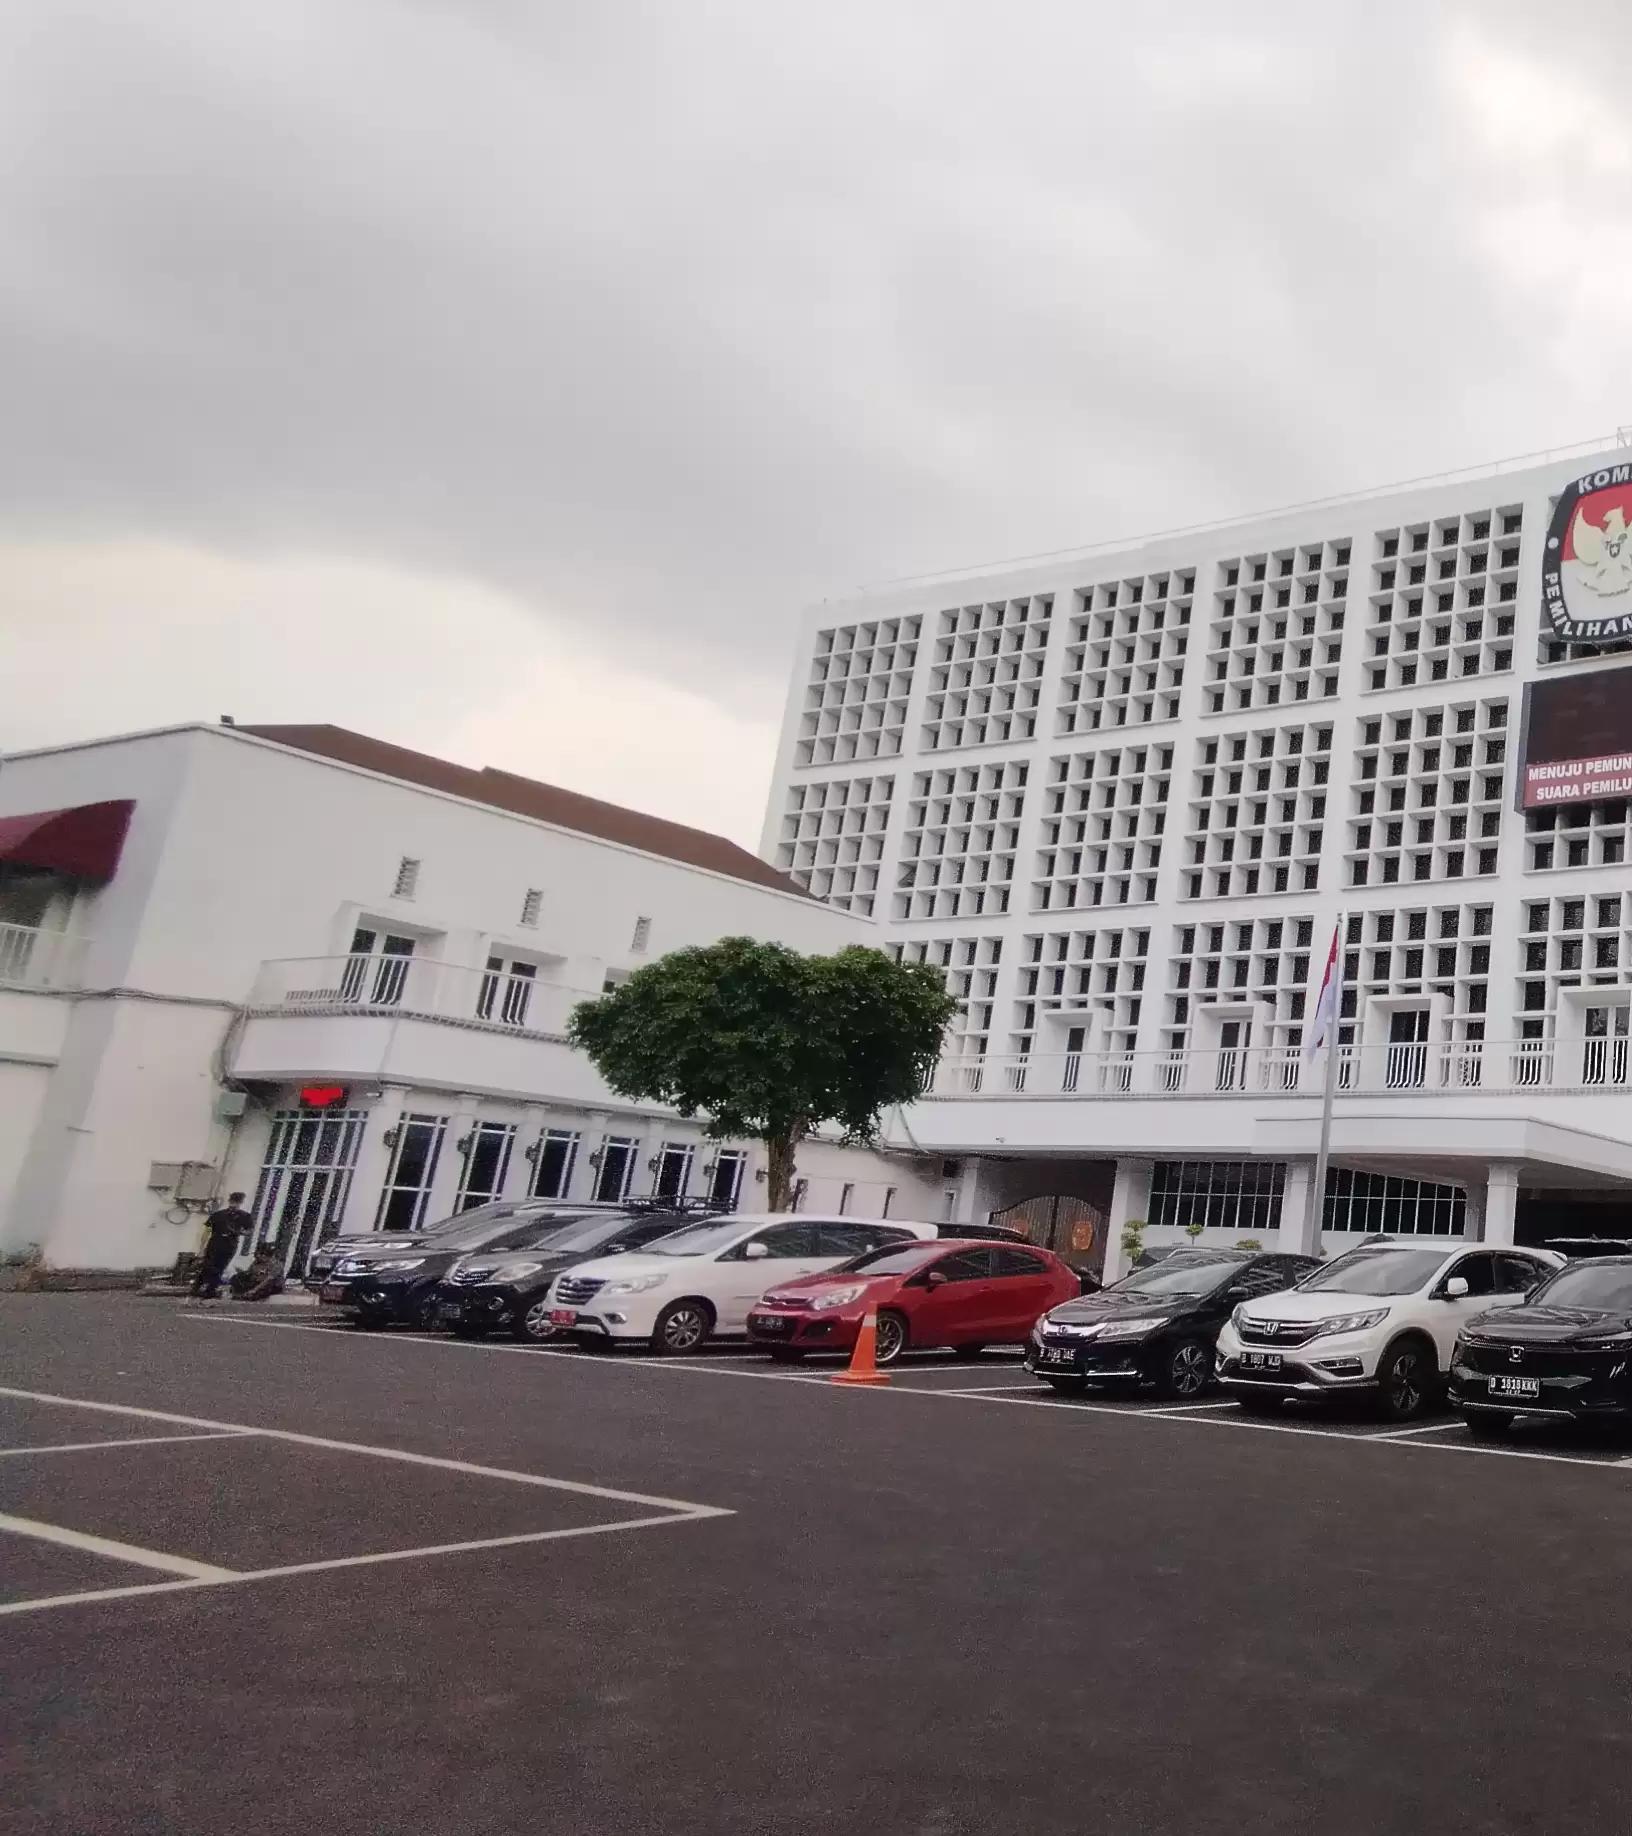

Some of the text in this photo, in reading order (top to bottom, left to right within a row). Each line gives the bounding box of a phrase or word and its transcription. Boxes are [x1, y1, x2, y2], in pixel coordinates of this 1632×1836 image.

[1528, 761, 1583, 781] MENUJU
[1536, 782, 1580, 801] SUARA
[1582, 777, 1632, 797] PEMILU
